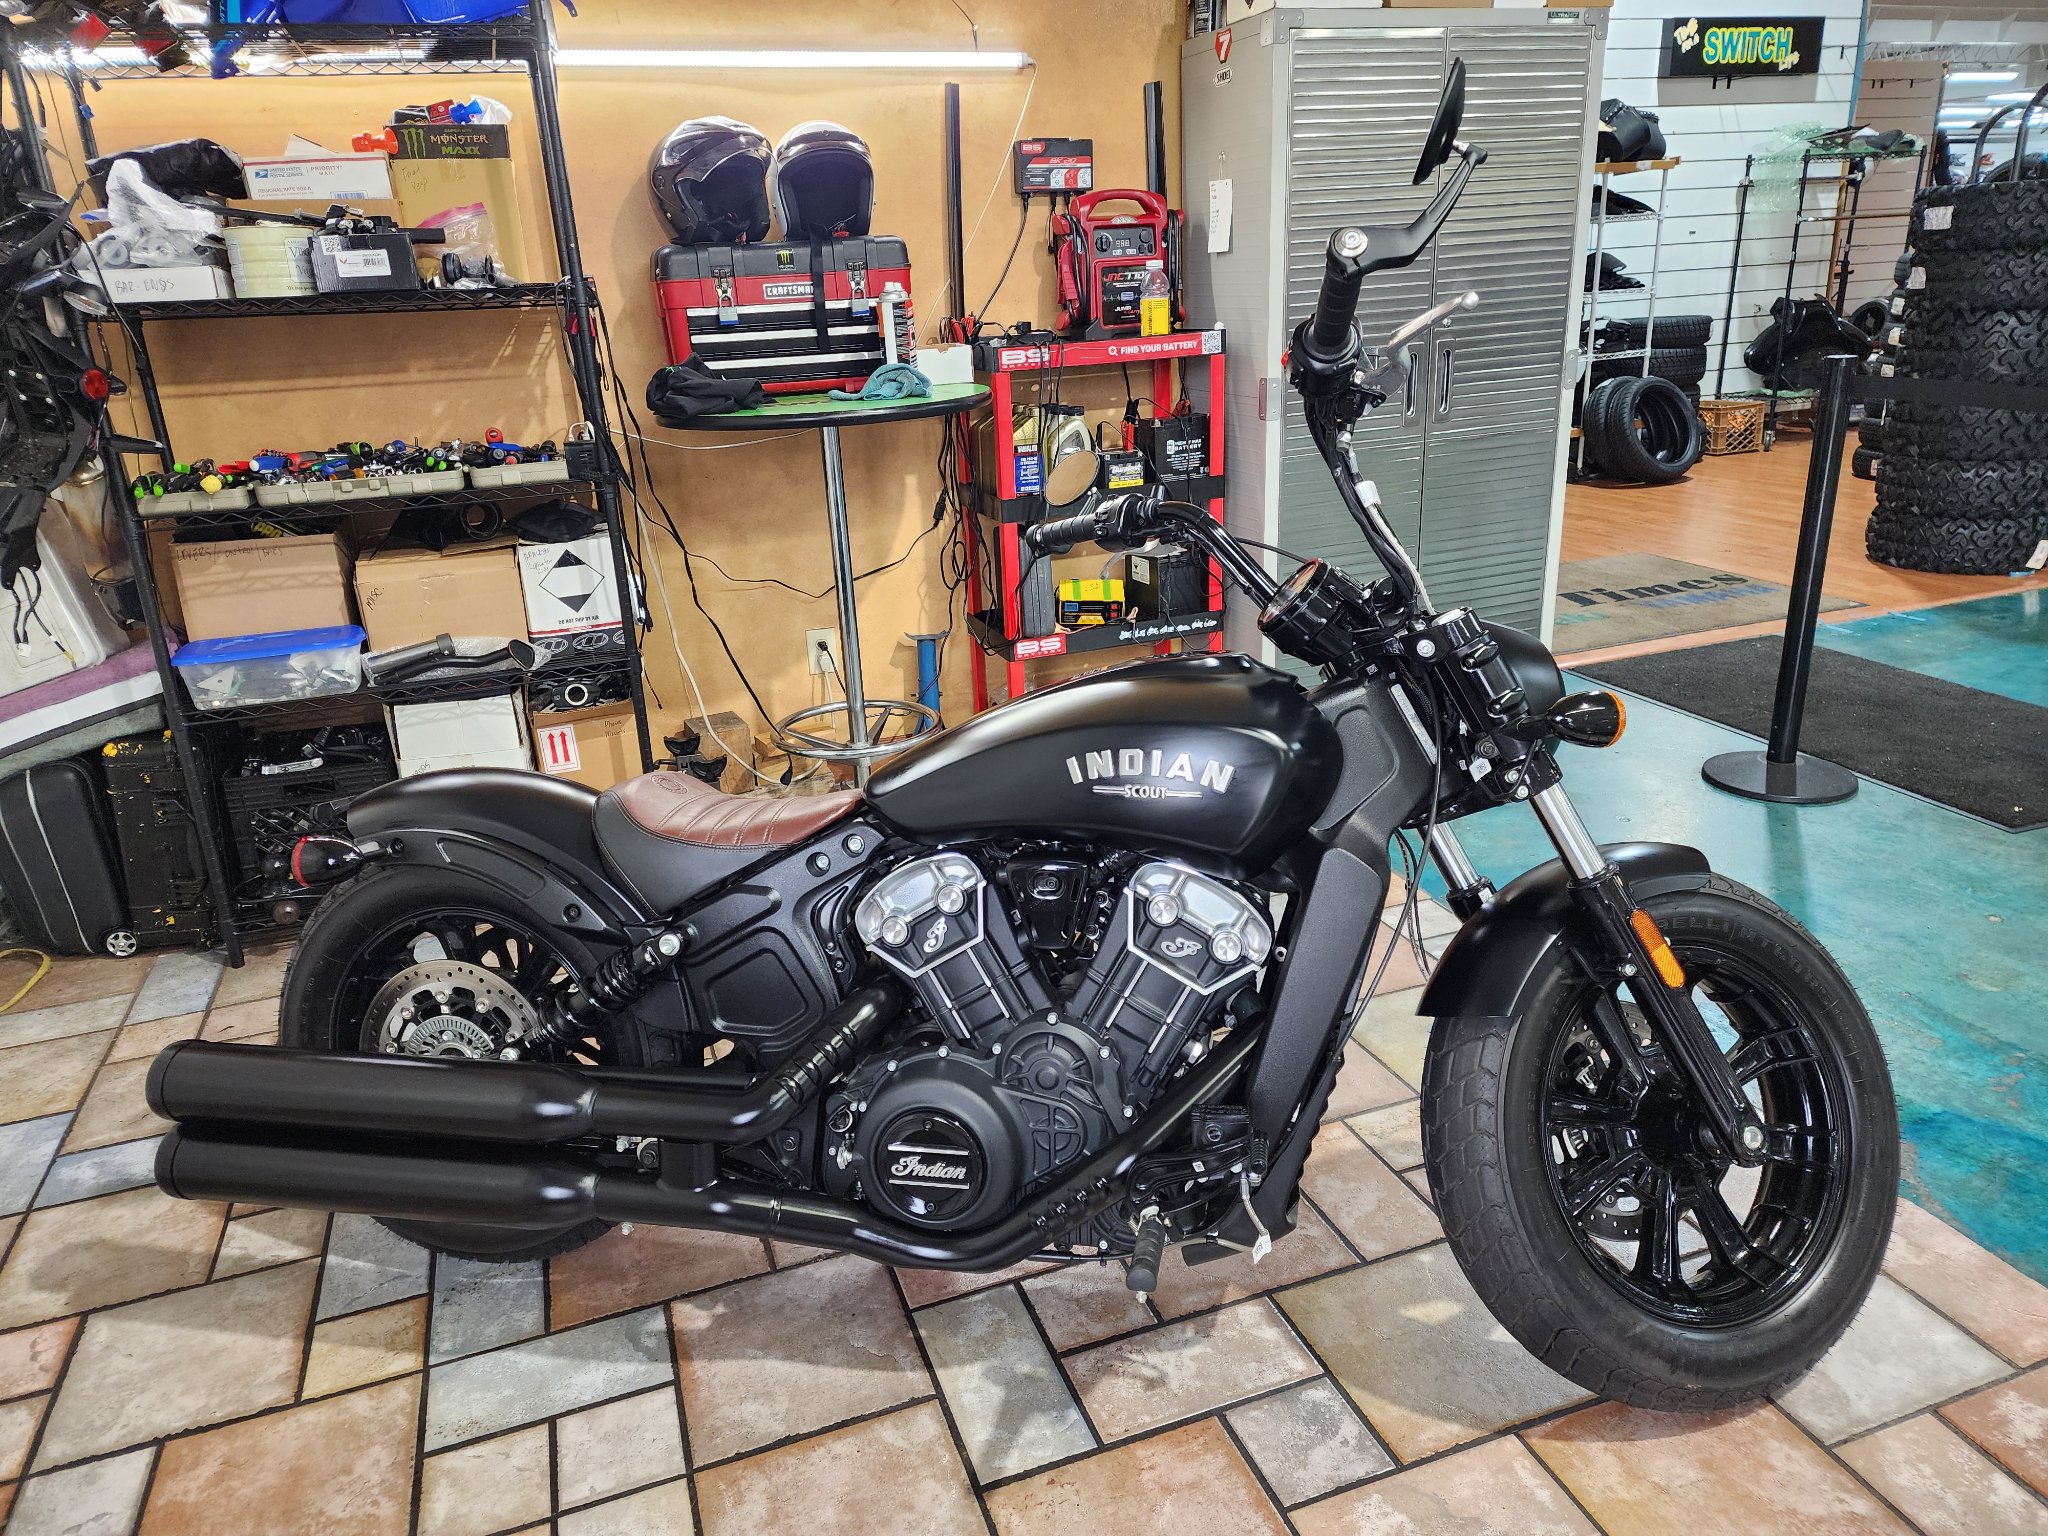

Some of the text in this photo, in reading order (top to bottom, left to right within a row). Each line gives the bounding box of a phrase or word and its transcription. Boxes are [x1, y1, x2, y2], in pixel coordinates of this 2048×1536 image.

[1219, 33, 1231, 61] 7
[1703, 26, 1793, 64] SWITCH
[1216, 69, 1231, 84] SHOEI
[430, 134, 489, 145] MONSTER
[441, 146, 481, 155] MAXX
[1023, 144, 1042, 152] BS
[1001, 347, 1049, 365] BS
[1120, 340, 1198, 356] FIND YOUR BATTERY
[1174, 443, 1202, 451] BATTERY
[1557, 574, 1749, 608] Times
[1016, 637, 1062, 655] BS
[1017, 649, 1062, 659] BATTERY
[1066, 748, 1237, 795] INDIAN
[1123, 784, 1169, 800] SCOUT
[890, 1154, 968, 1180] Indian
